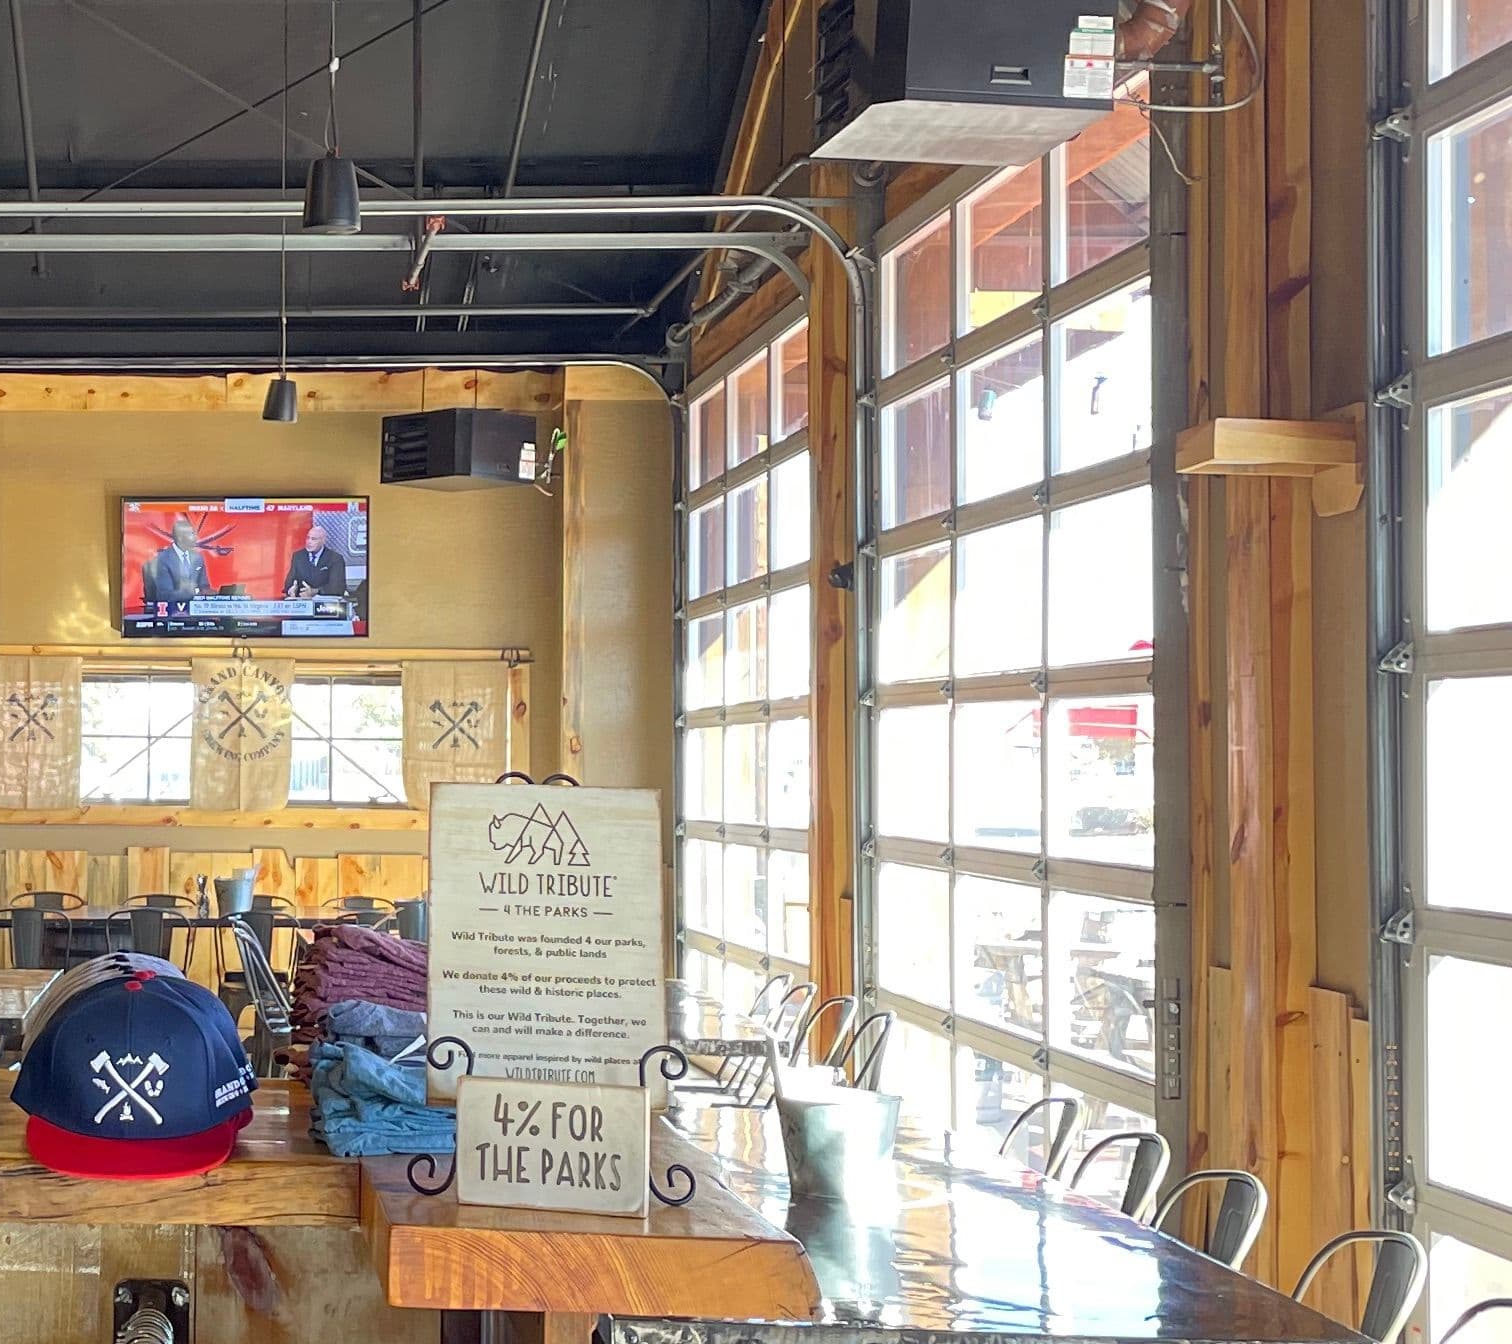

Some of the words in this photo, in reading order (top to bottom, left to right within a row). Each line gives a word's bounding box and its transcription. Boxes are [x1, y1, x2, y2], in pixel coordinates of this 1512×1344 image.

[478, 871, 529, 895] WILD
[536, 872, 614, 898] TRIBUTE
[503, 904, 511, 915] 4
[514, 904, 541, 917] THE
[544, 905, 589, 918] PARKS
[451, 931, 476, 941] Wild
[478, 932, 515, 942] Tribute
[518, 935, 538, 943] was
[540, 934, 583, 945] founded
[584, 935, 592, 945] 4
[594, 938, 613, 946] our
[614, 937, 647, 949] parks,
[493, 945, 532, 957] forests,
[534, 947, 543, 957] &
[545, 947, 577, 959] public
[579, 948, 608, 959] lands
[442, 969, 460, 980] We
[462, 970, 499, 981] donate
[500, 972, 519, 982] 4%
[521, 972, 532, 982] of
[534, 975, 553, 983] our
[554, 975, 602, 986] proceeds
[604, 976, 616, 986] to
[618, 977, 657, 988] protect
[479, 984, 507, 994] these
[509, 986, 532, 995] wild
[534, 986, 543, 996] &
[545, 987, 584, 997] historic
[586, 989, 622, 1000] places.
[452, 1009, 474, 1020] This
[476, 1010, 485, 1020] is
[487, 1012, 506, 1021] our
[507, 1011, 532, 1022] Wild
[534, 1012, 575, 1024] Tribute.
[577, 1014, 628, 1027] Together,
[631, 1018, 647, 1026] we
[471, 1025, 491, 1034] can
[492, 1025, 512, 1035] and
[514, 1026, 533, 1035] will
[535, 1026, 564, 1037] make
[574, 1027, 630, 1039] difference.
[478, 1052, 501, 1060] more
[502, 1053, 534, 1062] apparel
[535, 1053, 569, 1064] inspired
[571, 1056, 582, 1065] by
[584, 1056, 603, 1064] wild
[604, 1057, 631, 1066] places
[504, 1066, 596, 1084] WILDTRIBUTECOM
[493, 1092, 543, 1137] 4%
[551, 1101, 604, 1143] FOR
[475, 1142, 531, 1184] THE
[541, 1147, 622, 1192] PARKS
